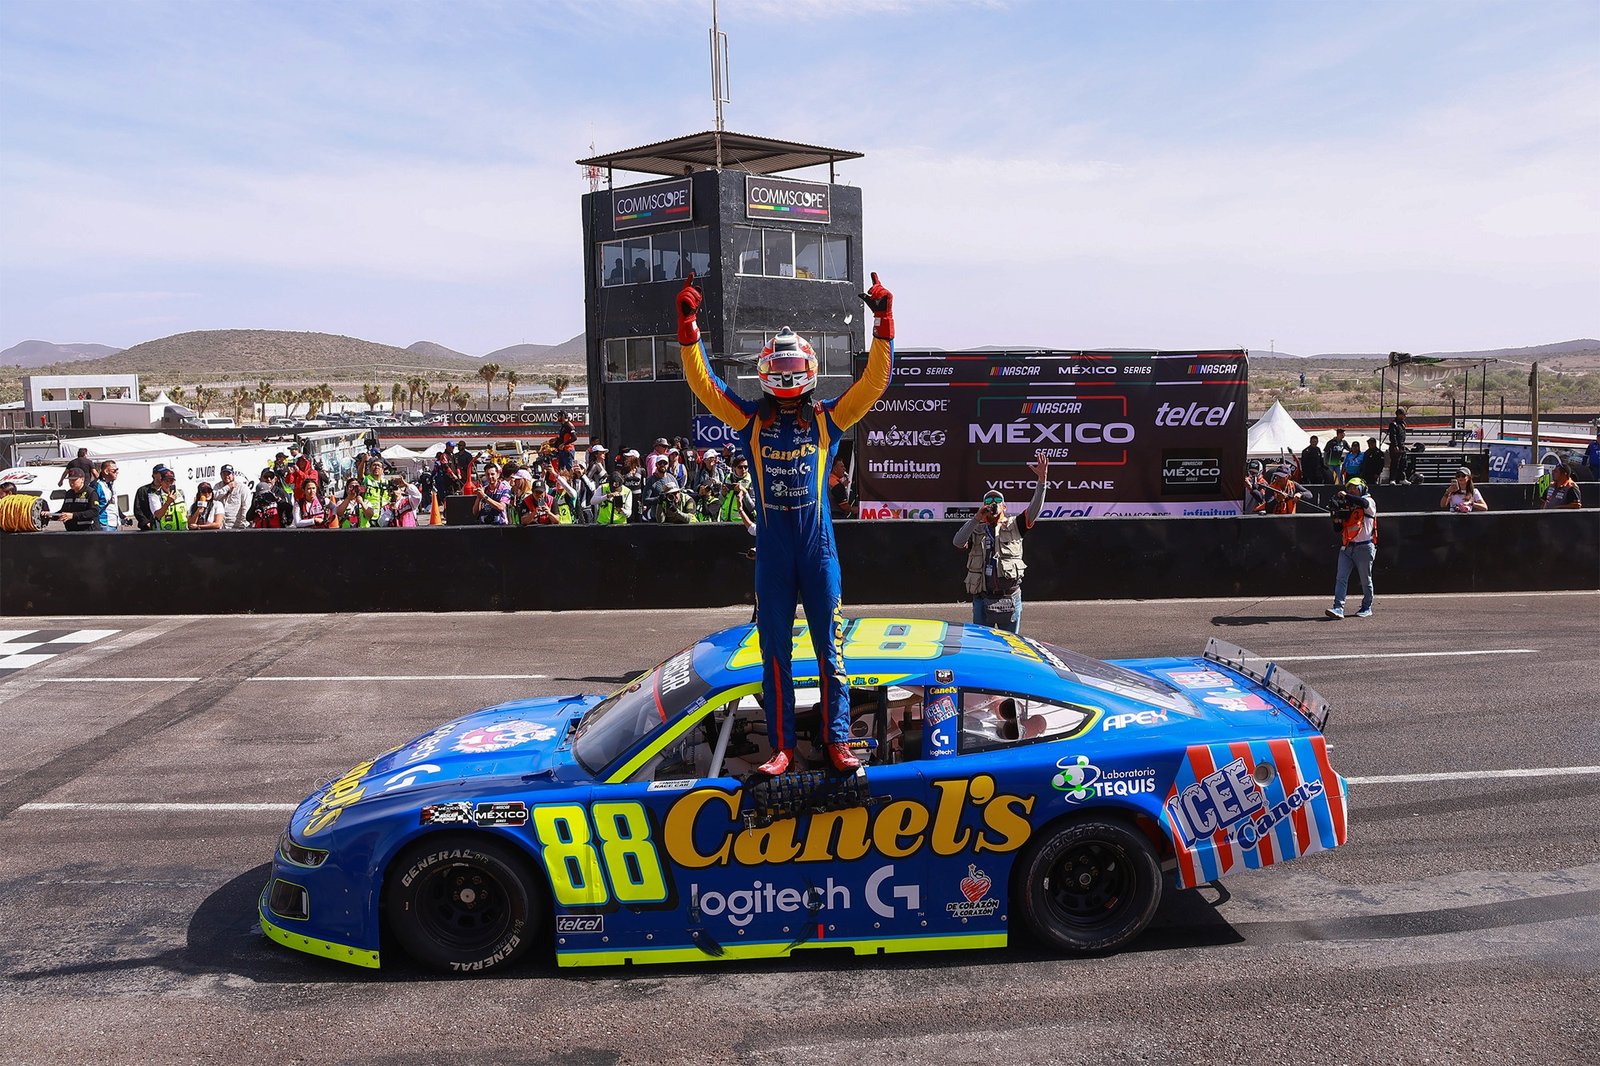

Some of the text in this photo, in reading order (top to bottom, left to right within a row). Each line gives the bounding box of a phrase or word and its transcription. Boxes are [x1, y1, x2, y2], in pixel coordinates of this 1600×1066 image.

[617, 190, 687, 215] COMMSCOPE
[751, 187, 823, 207] COMMSCOPE
[926, 367, 953, 375] SERIES
[1002, 366, 1041, 376] NASCAR
[1058, 364, 1152, 375] MÉXICO SERIES
[1199, 364, 1238, 374] NASCAR
[1036, 402, 1082, 414] NASCAR
[1155, 401, 1236, 427] telcel
[455, 412, 515, 424] COMMSCOPE
[520, 412, 583, 423] COMMSOPE
[968, 417, 1135, 444] MÉXICO
[761, 443, 816, 461] Canel's
[1034, 448, 1069, 458] SERIES
[765, 464, 798, 476] logitech
[868, 459, 941, 473] infinitum
[1162, 467, 1220, 477] MÉXICO
[912, 472, 941, 480] Velocidad
[986, 480, 1114, 490] VICTORY LANE
[945, 509, 976, 519] MÉXIC
[1040, 505, 1093, 518] elcel
[930, 686, 958, 695] Canel's
[1103, 709, 1169, 731] APEX
[1102, 767, 1155, 780] Laboratorio
[1094, 778, 1156, 797] TEQUIS
[1166, 757, 1263, 849] ICEE
[475, 810, 526, 819] MÉXICO
[1237, 780, 1323, 850] Canel's
[663, 775, 1036, 868] Canel's
[531, 800, 669, 907] 88
[401, 849, 474, 887] GENERAL
[690, 877, 851, 926] logitech
[959, 899, 999, 910] CORAZÓN
[960, 908, 992, 916] CORAZÓN
[558, 917, 601, 931] telcel
[450, 934, 521, 971] GENERAL
